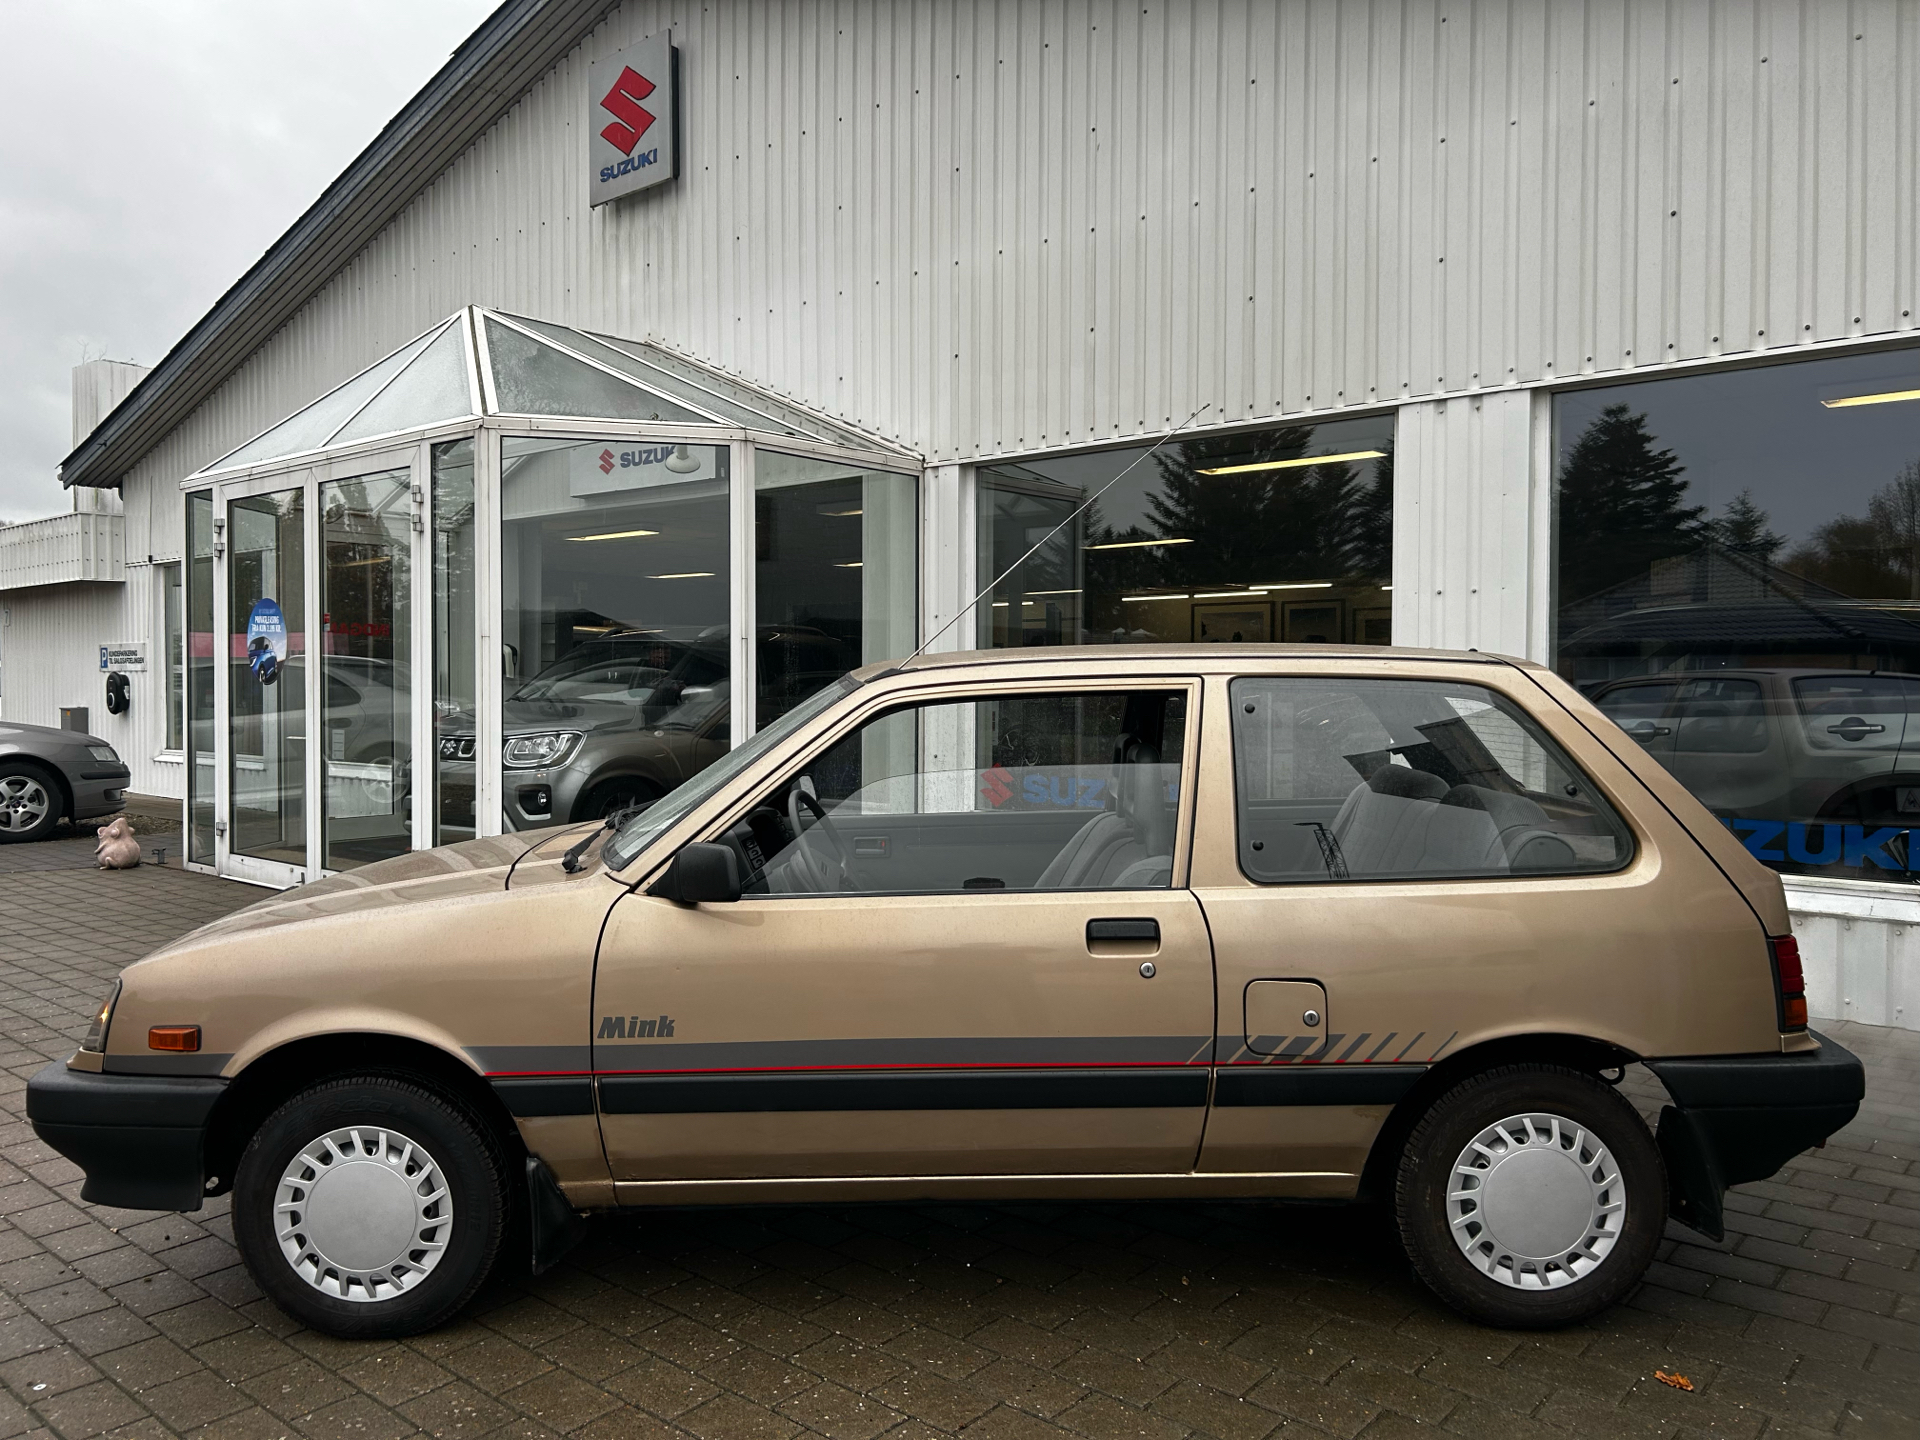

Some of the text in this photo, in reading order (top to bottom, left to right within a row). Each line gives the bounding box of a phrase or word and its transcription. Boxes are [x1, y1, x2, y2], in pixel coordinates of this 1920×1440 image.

[600, 148, 658, 183] SUZUKI
[620, 445, 676, 468] SUZUK
[1719, 817, 1920, 871] ZUKI
[597, 1015, 675, 1039] Mink
